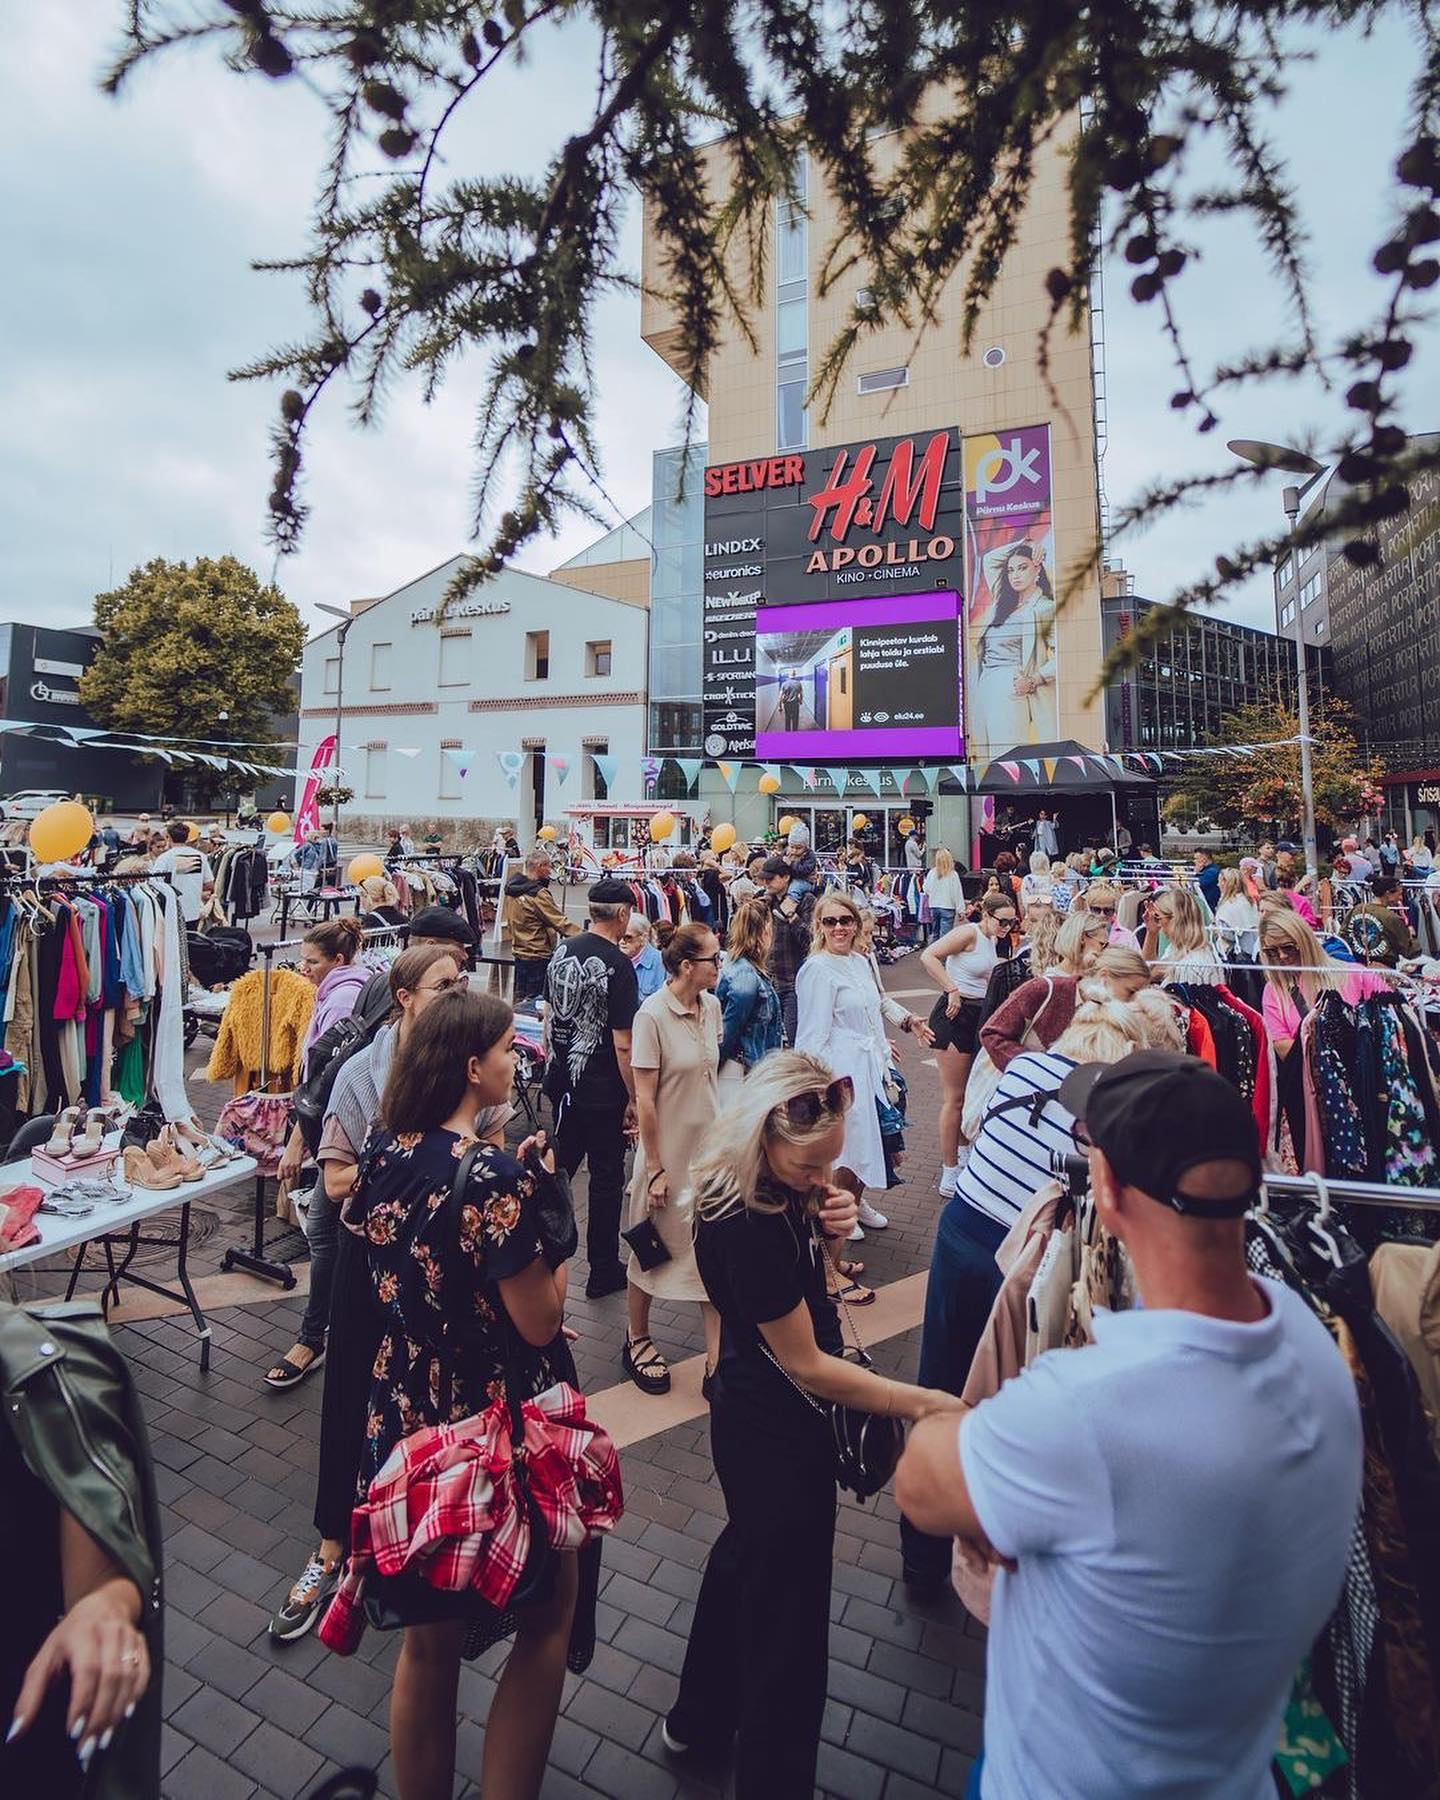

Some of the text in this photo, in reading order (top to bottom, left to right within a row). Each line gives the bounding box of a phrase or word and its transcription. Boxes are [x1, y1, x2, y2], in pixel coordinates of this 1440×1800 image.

[705, 455, 804, 497] SELVER
[975, 437, 1042, 504] pk
[808, 432, 949, 541] H&M
[705, 538, 761, 557] LINDEX
[806, 536, 955, 573] APOLLO
[712, 565, 761, 580] euronics
[836, 566, 921, 585] KINO CINEMA
[860, 634, 938, 648] Kinnipeetav kurdab
[860, 645, 945, 659] lahja toidu ja arstiabi
[860, 660, 893, 671] puuduse
[893, 712, 925, 721] elu24.ee
[847, 773, 893, 787] kesus
